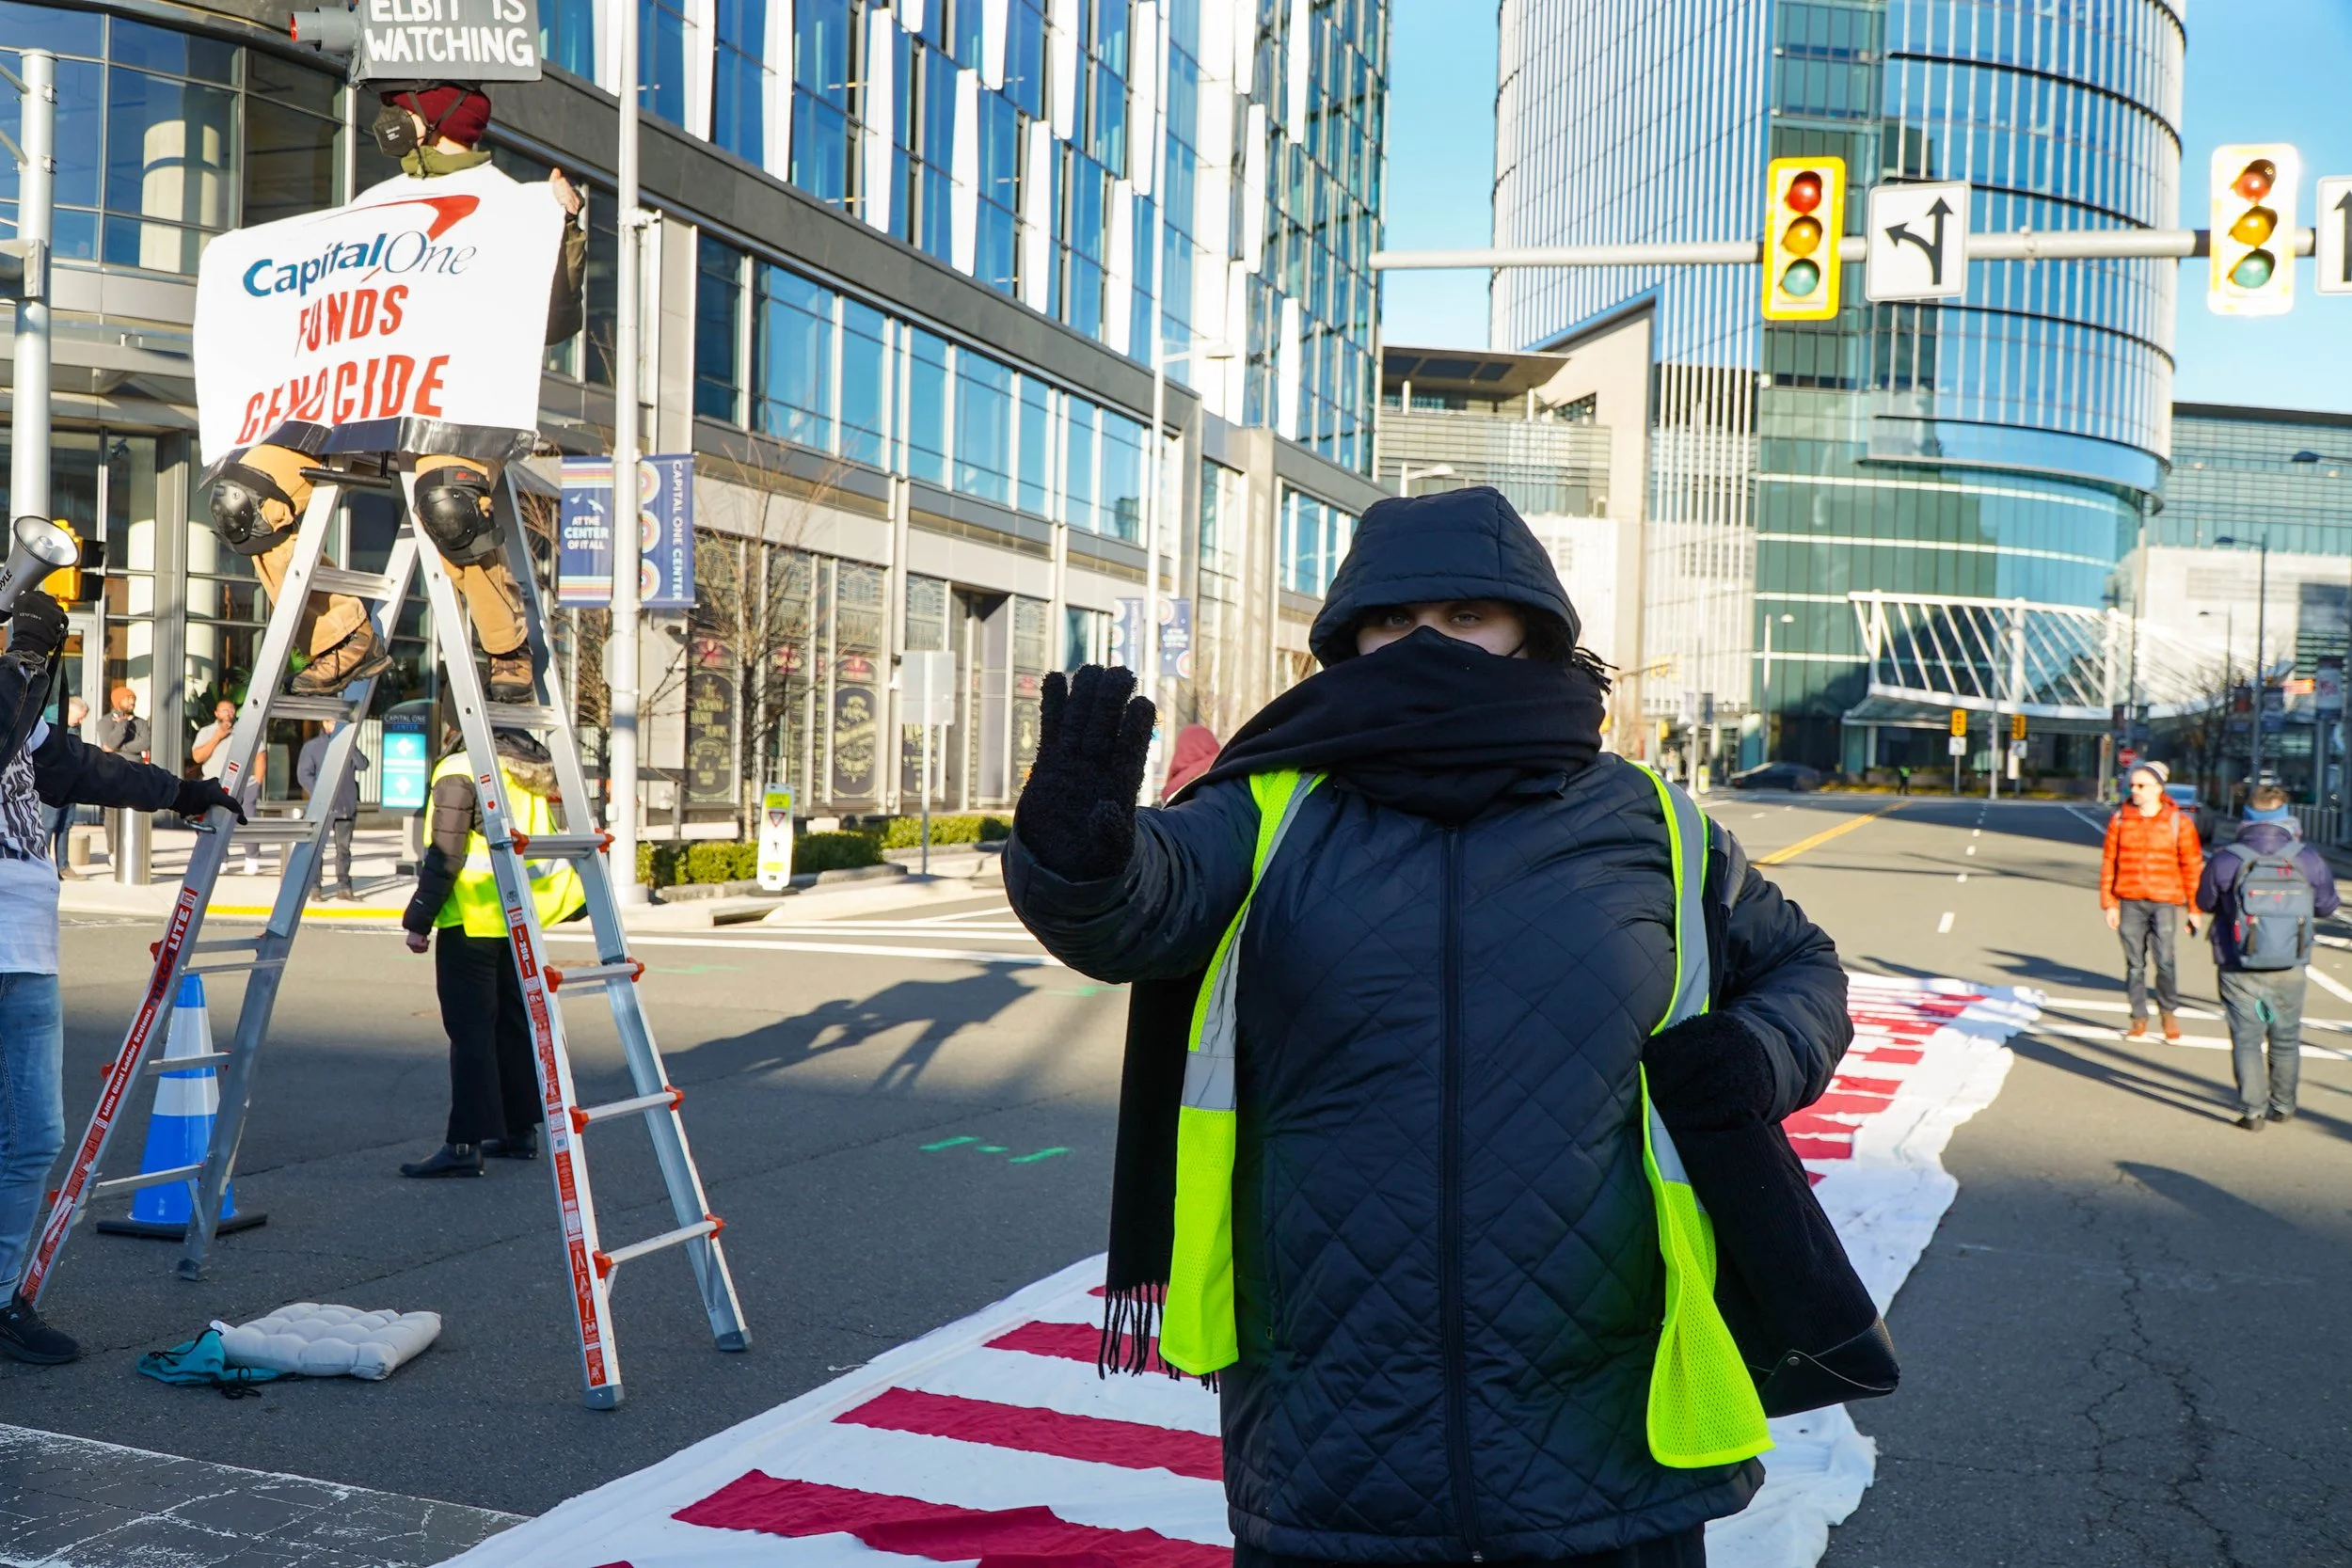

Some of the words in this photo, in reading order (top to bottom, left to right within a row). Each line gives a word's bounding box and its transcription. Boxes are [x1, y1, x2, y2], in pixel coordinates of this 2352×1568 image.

[369, 0, 459, 22] ELBIT
[492, 0, 527, 23] IS
[364, 25, 534, 68] WATCHING
[294, 284, 409, 358] FUNDS
[235, 355, 451, 445] GENOCIDE
[672, 459, 684, 515] CAPITAL
[564, 527, 609, 539] CENTER
[571, 516, 584, 526] AT
[584, 516, 600, 526] THE
[672, 516, 684, 546] ONE
[567, 540, 580, 550] OF
[580, 540, 589, 550] IT
[589, 540, 605, 550] ALL
[672, 548, 684, 601] CENTER
